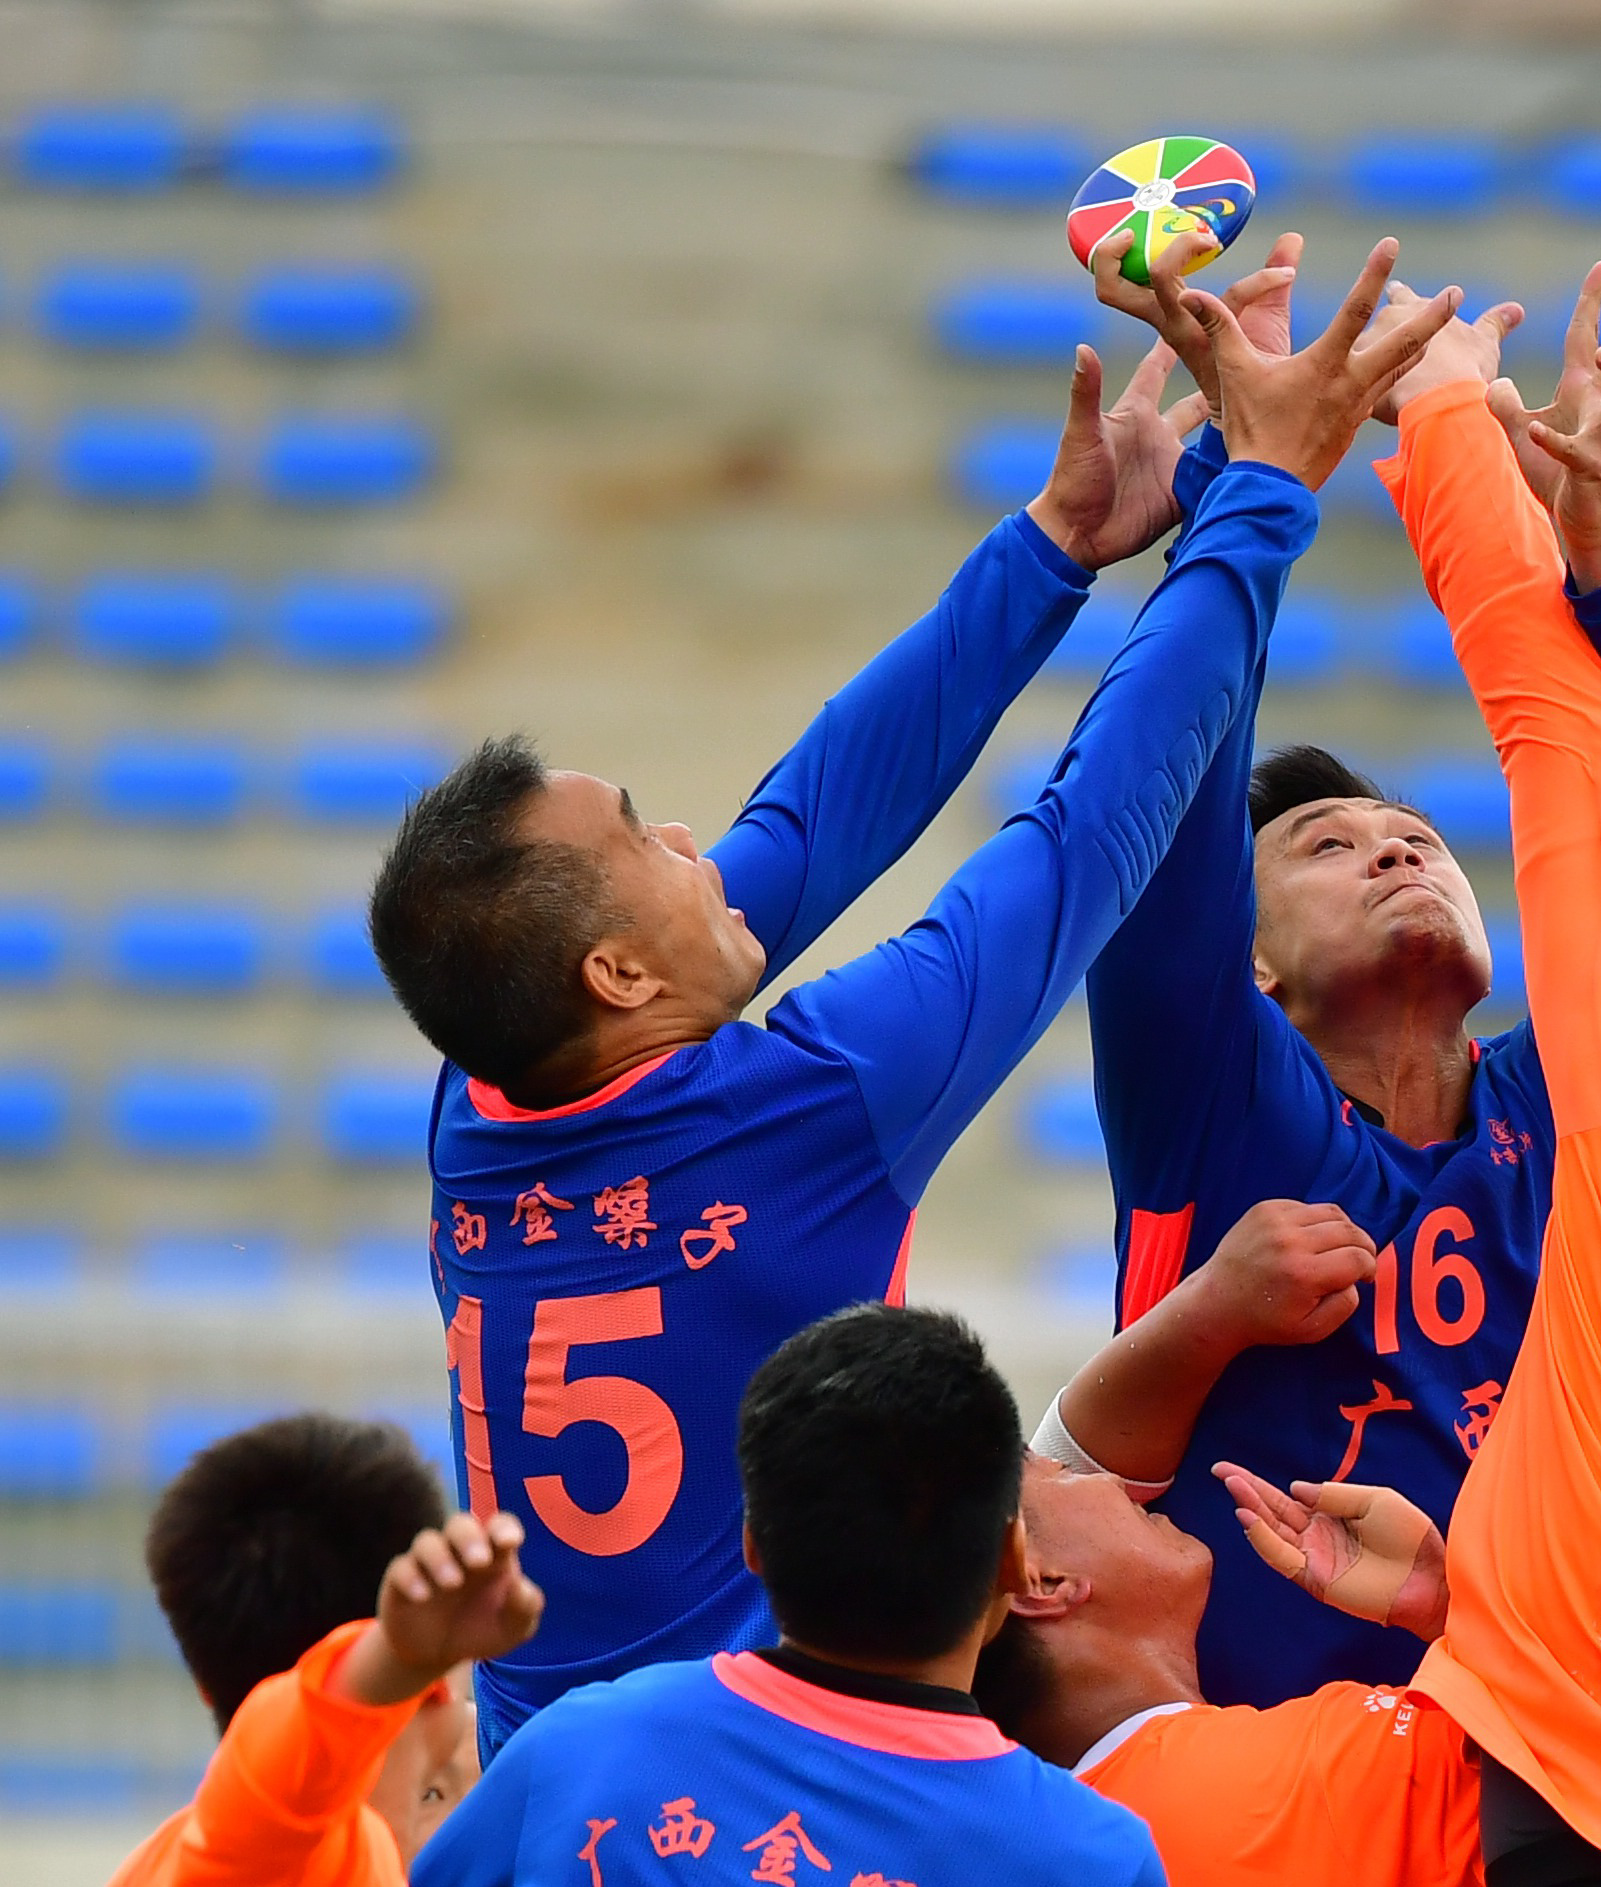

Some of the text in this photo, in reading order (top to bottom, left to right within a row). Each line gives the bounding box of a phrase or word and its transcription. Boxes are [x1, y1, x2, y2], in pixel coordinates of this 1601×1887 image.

[1374, 1206, 1486, 1355] 16
[447, 1286, 684, 1557] 15
[1392, 1703, 1414, 1736] KEL
